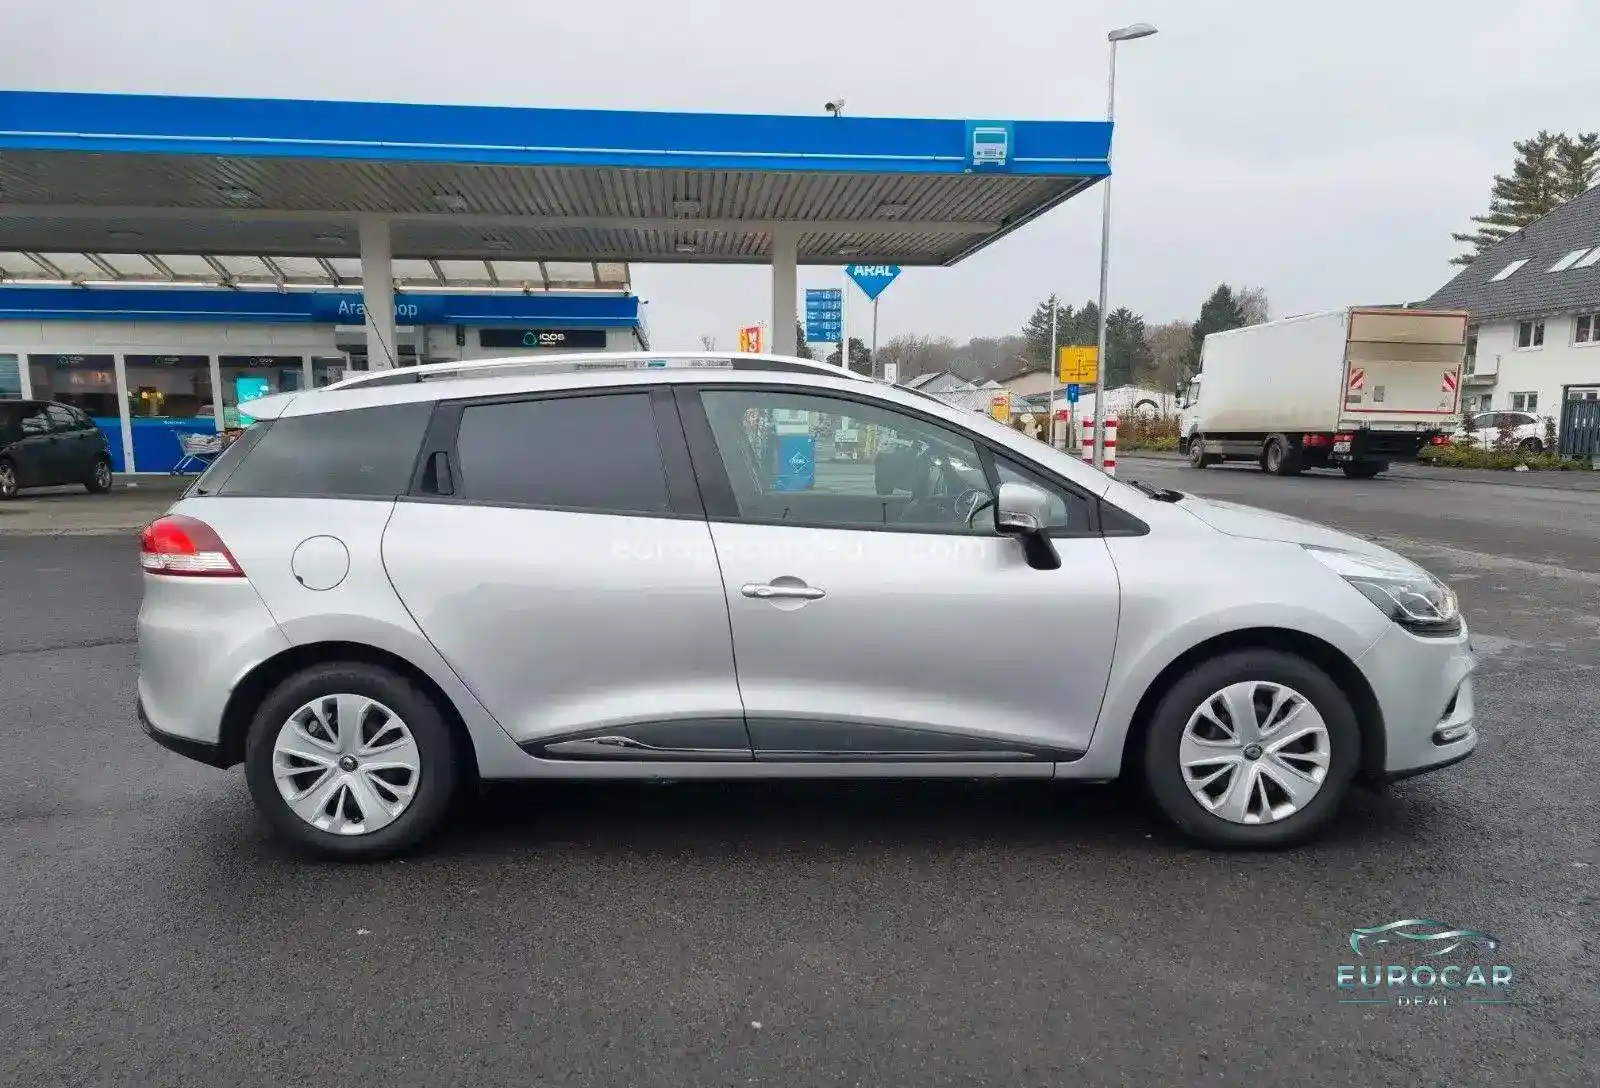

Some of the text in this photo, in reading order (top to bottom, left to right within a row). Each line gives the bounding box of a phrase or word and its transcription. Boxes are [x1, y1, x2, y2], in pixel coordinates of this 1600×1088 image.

[853, 265, 894, 277] ARAL
[338, 300, 365, 316] Ara
[539, 333, 565, 341] IQOS
